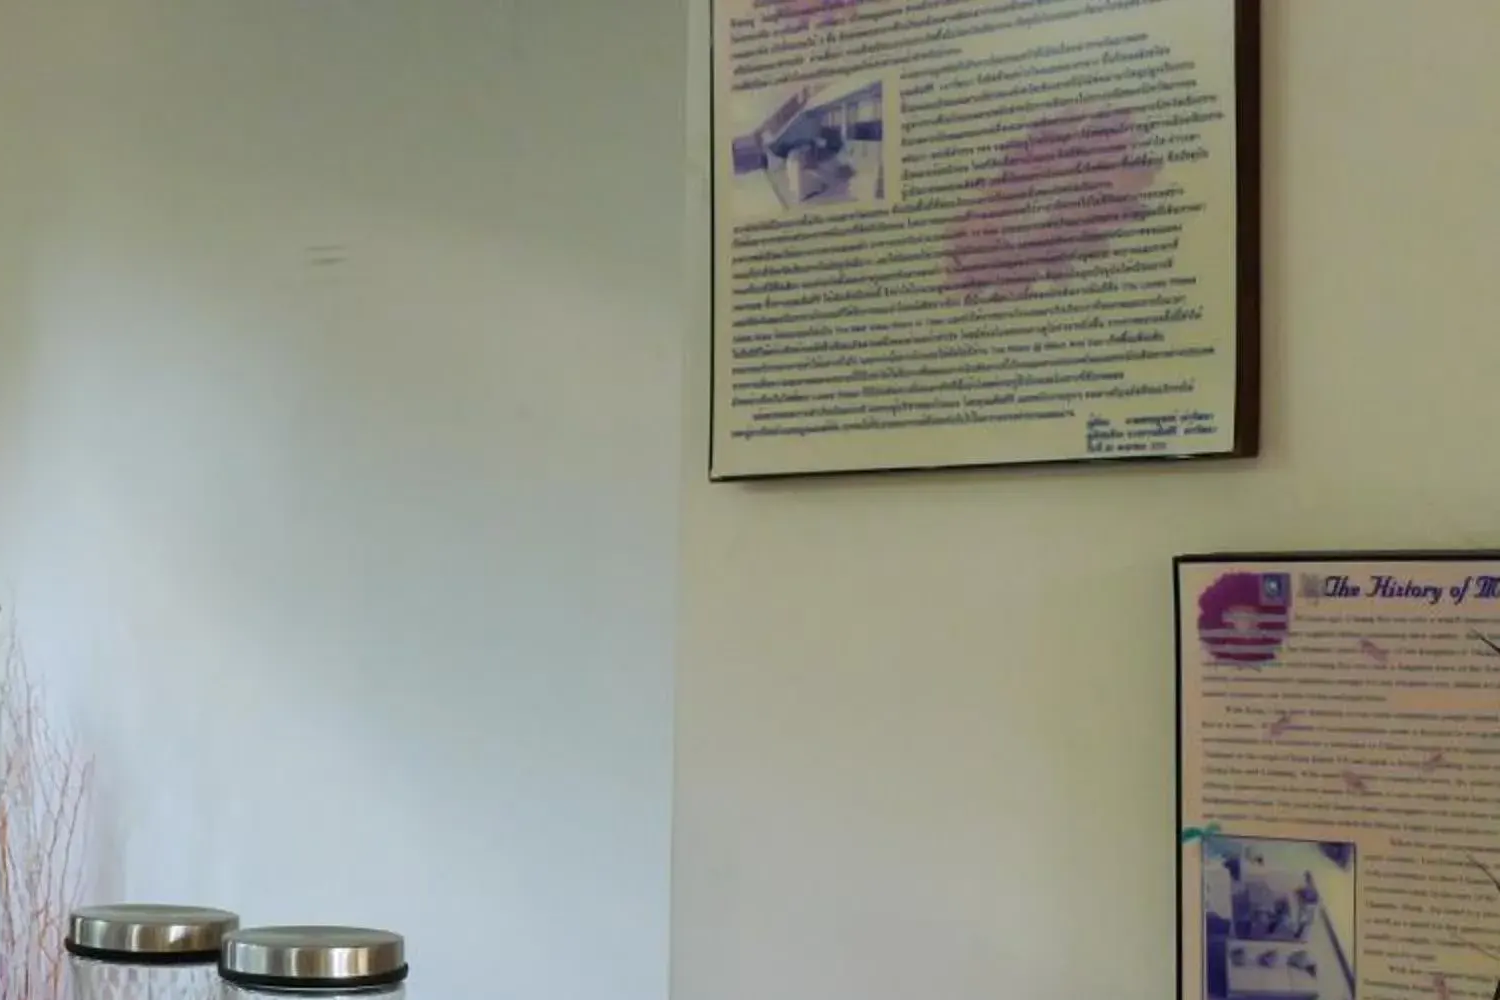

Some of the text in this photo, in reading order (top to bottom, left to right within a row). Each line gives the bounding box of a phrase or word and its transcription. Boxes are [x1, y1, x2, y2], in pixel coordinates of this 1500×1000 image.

[1324, 576, 1361, 597] The
[1366, 575, 1443, 605] History
[1450, 576, 1473, 605] of
